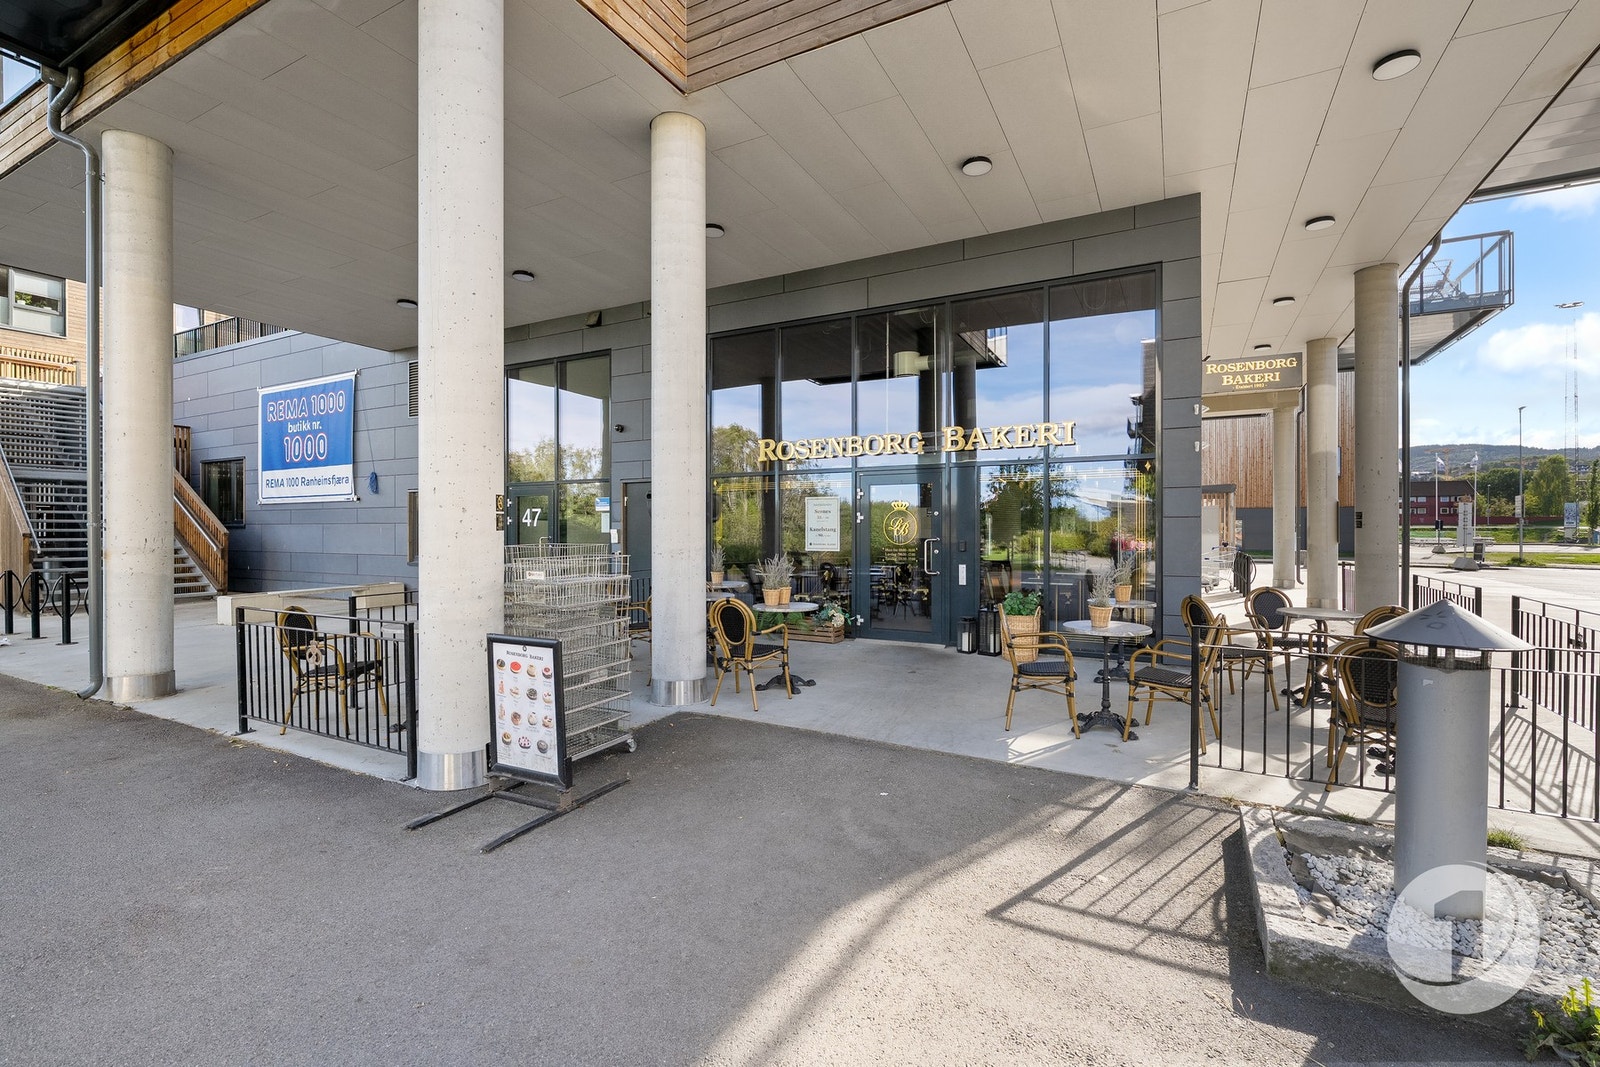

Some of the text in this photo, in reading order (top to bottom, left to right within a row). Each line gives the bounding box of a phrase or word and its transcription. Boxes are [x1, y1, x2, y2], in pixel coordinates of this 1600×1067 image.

[1206, 358, 1297, 374] ROSENBORG
[1222, 372, 1280, 386] BAKERI
[267, 390, 345, 422] REMA 1000
[287, 420, 322, 433] butikk nr.
[283, 432, 327, 462] 1000
[758, 421, 1076, 462] ROSENBORG BAKERI
[265, 476, 285, 488] REMA
[286, 476, 300, 488] 1000
[522, 508, 541, 527] 47
